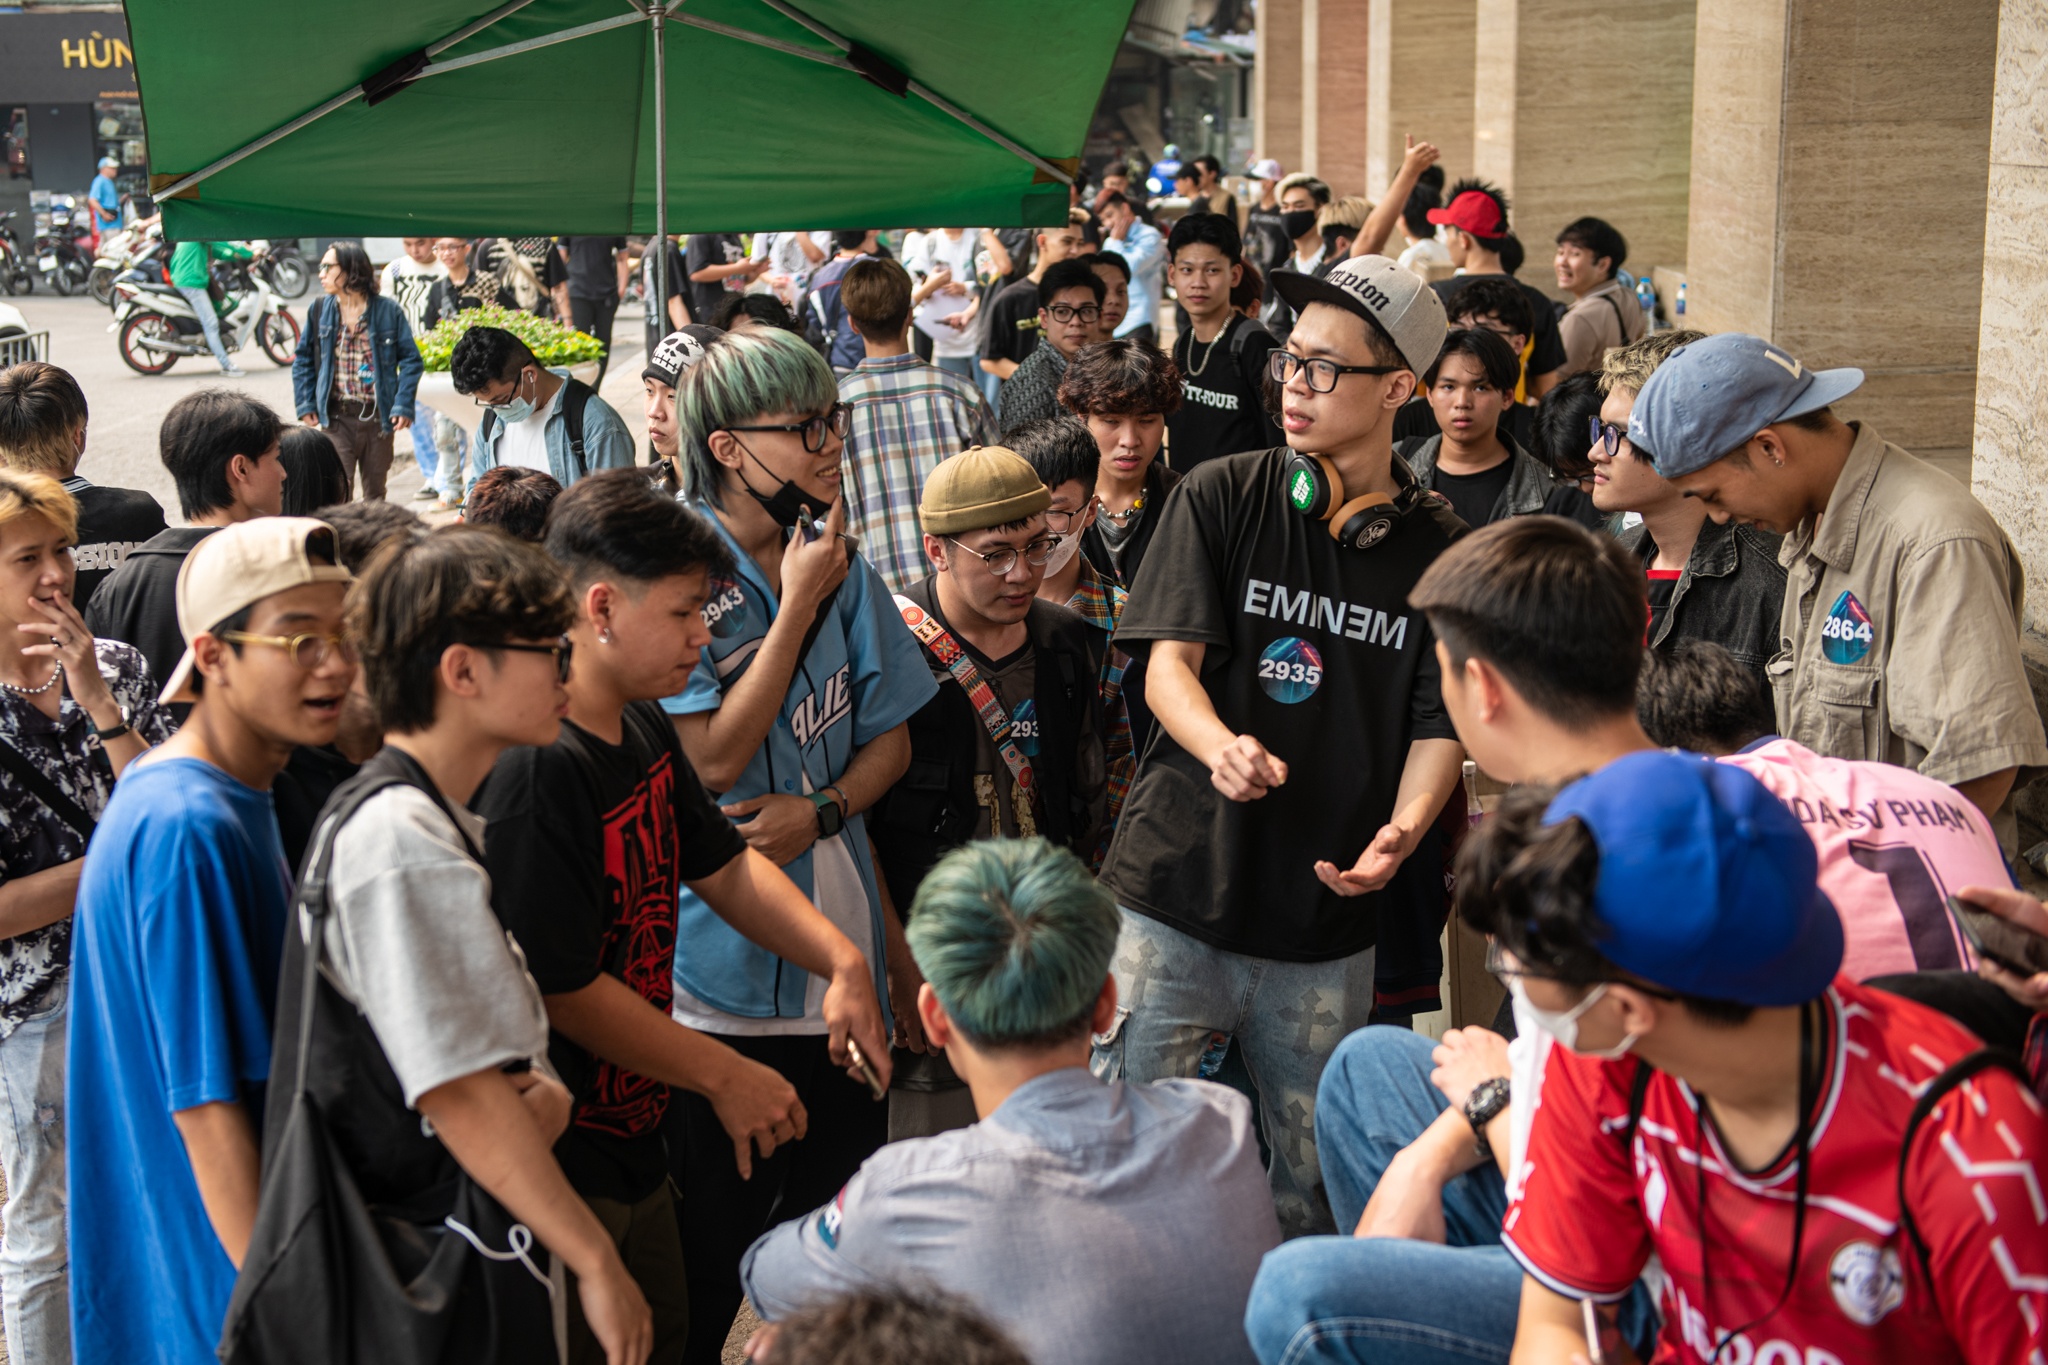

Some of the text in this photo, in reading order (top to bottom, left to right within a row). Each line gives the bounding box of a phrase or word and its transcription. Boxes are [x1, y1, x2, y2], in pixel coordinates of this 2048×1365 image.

[699, 586, 744, 628] 2943
[1822, 615, 1873, 643] 2864
[1258, 658, 1321, 685] 2935
